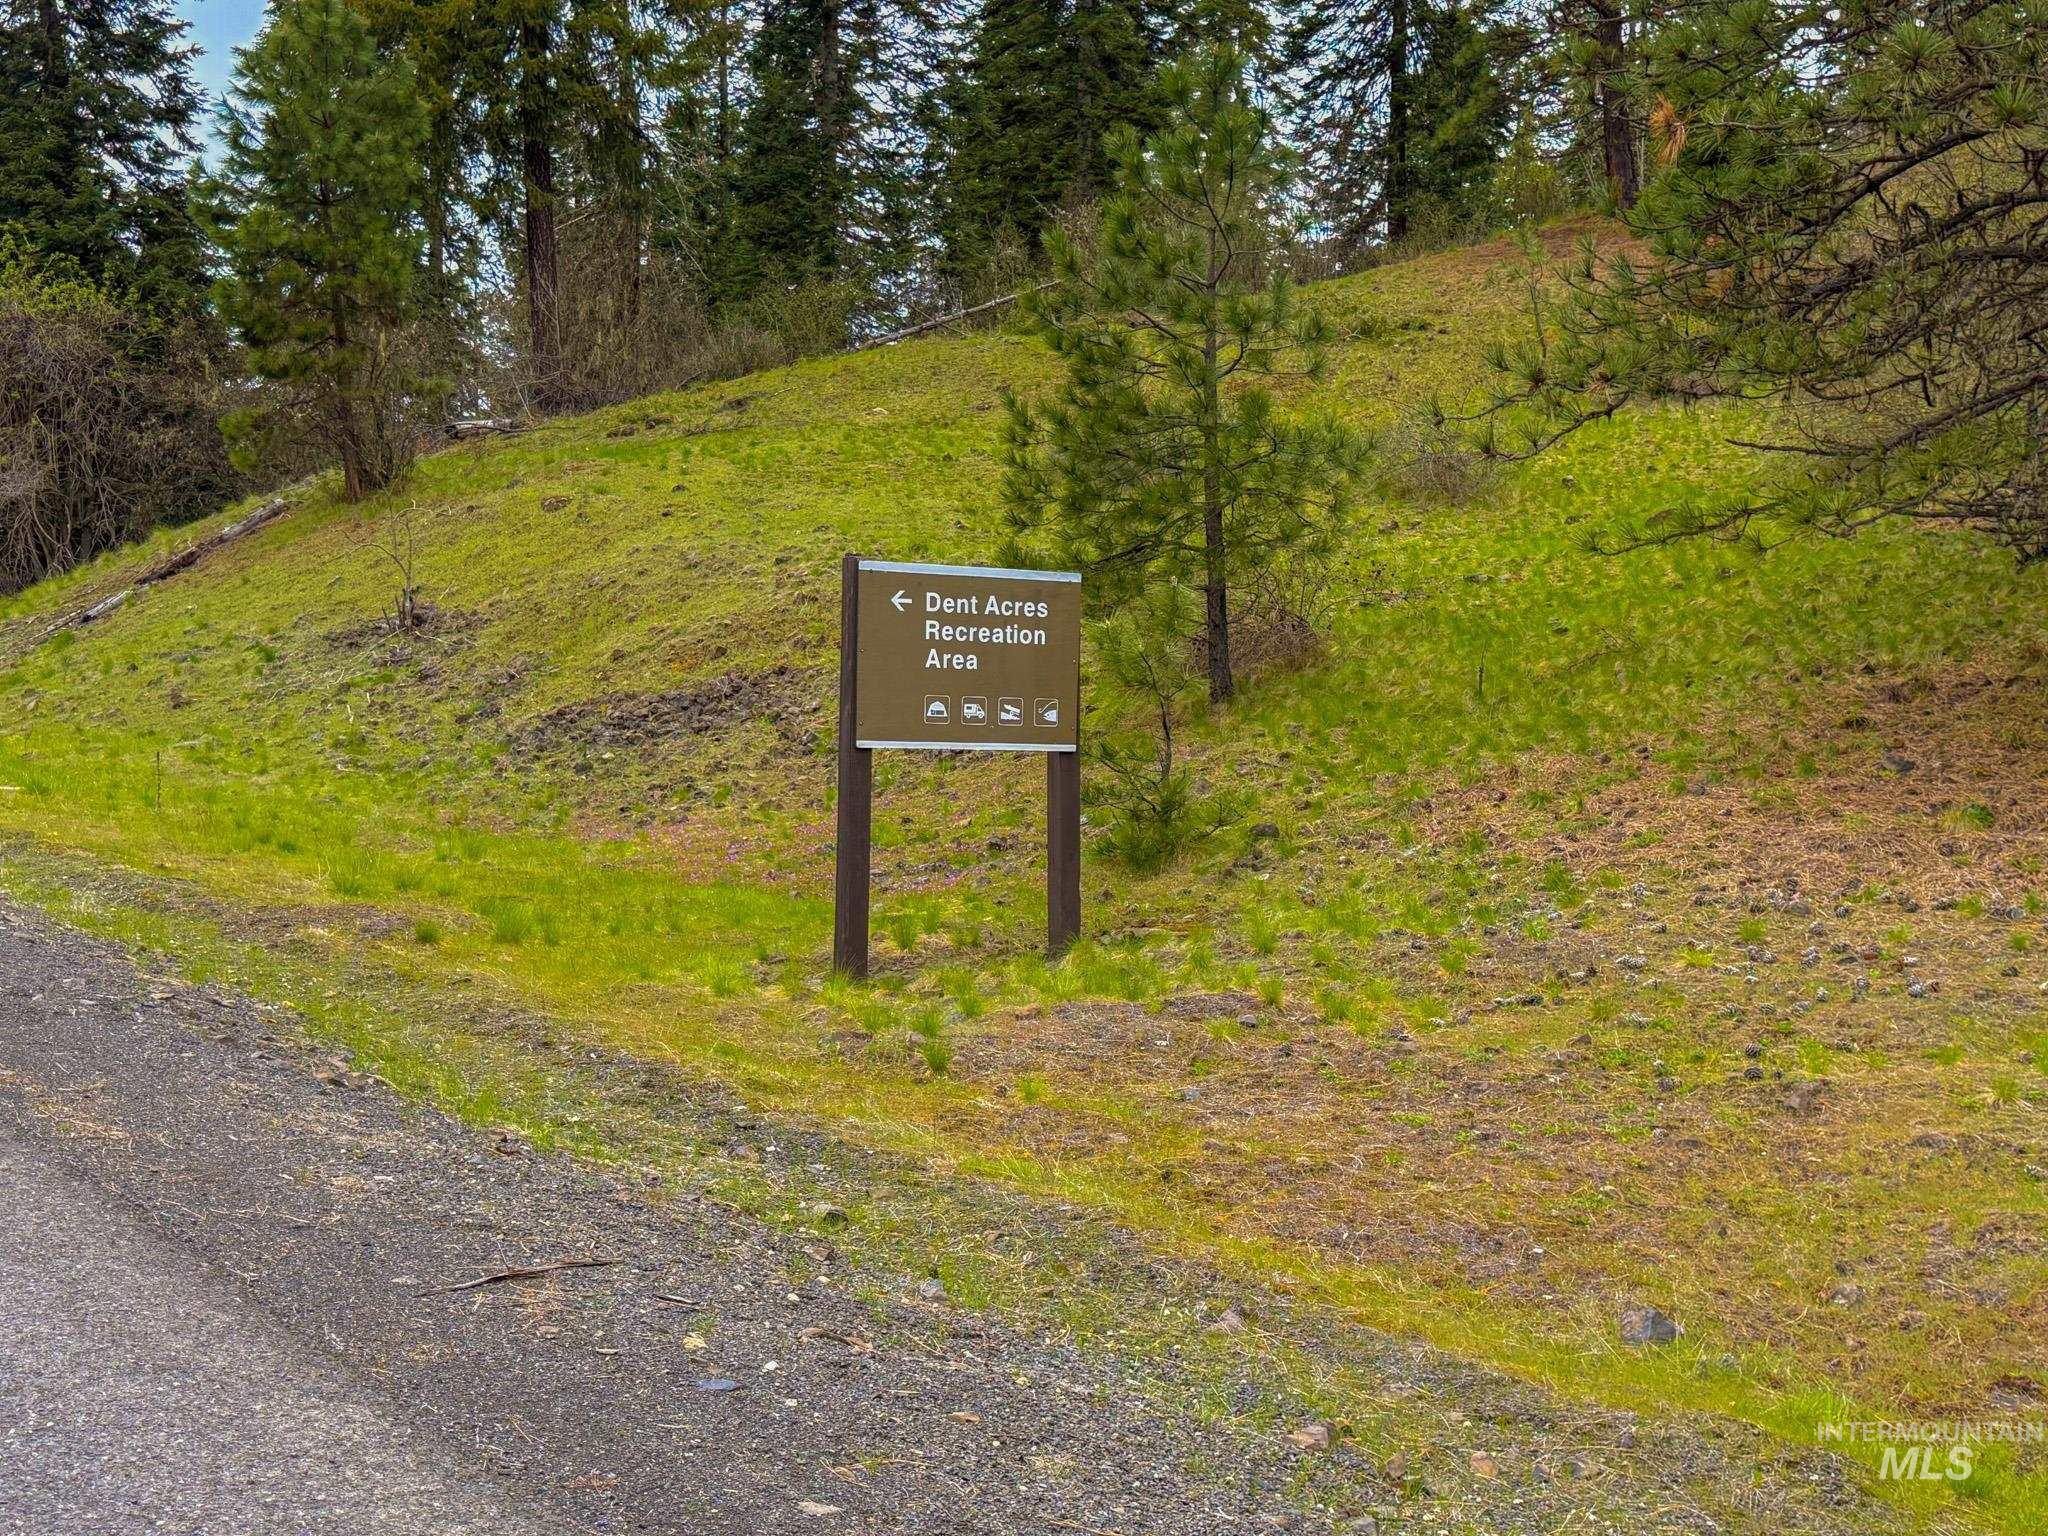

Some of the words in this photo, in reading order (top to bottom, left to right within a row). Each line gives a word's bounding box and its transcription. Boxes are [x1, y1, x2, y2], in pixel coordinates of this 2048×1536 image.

[925, 592, 978, 614] Dent
[984, 595, 1048, 618] Acres
[925, 620, 1046, 645] Recreation
[925, 649, 978, 670] Area
